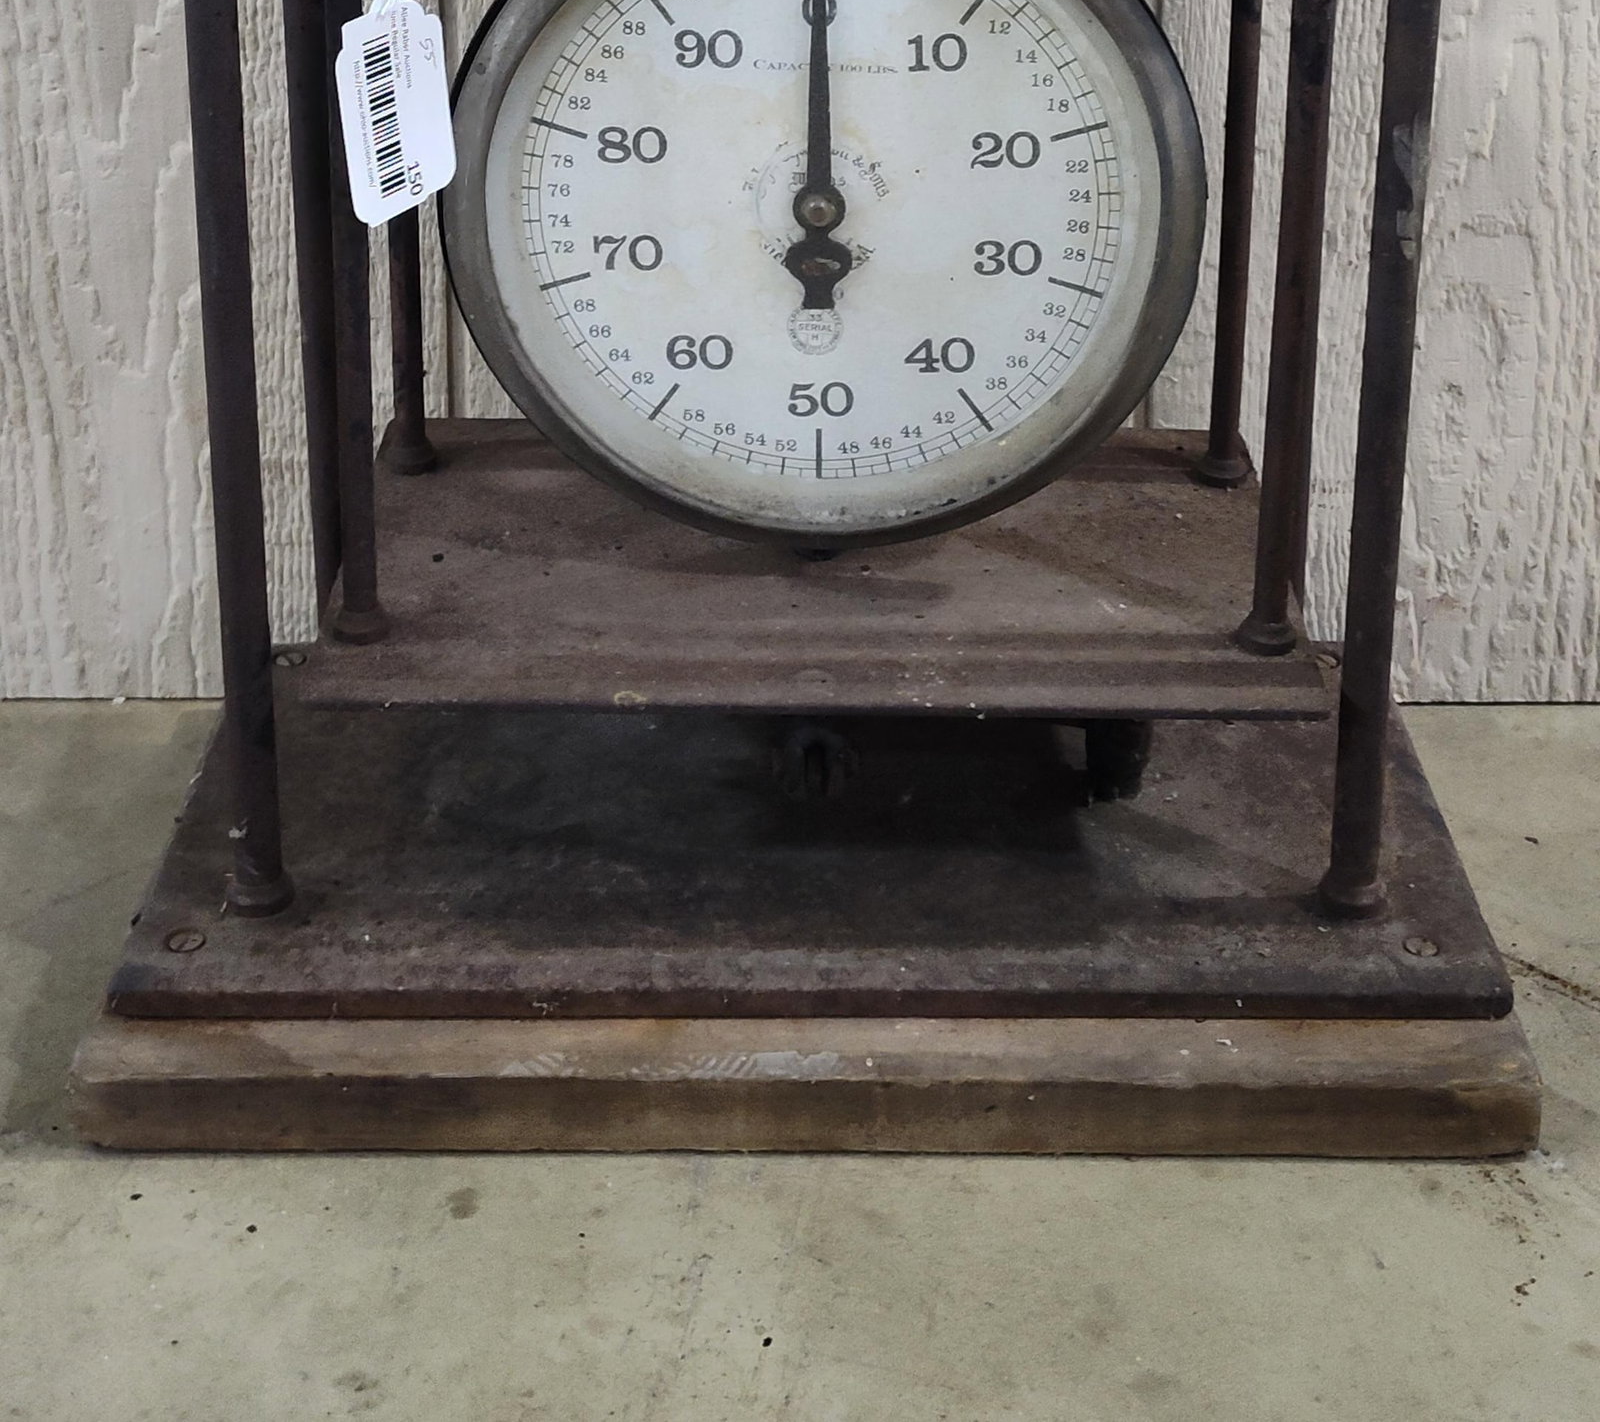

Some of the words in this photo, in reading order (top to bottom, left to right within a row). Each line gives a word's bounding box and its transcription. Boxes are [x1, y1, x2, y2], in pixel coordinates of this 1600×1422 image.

[623, 21, 645, 35] 88
[989, 20, 1011, 34] 12
[391, 30, 400, 60] Regular
[601, 45, 624, 59] 86
[674, 30, 742, 68] 90
[908, 34, 967, 72] 10
[1016, 49, 1037, 63] 14
[404, 54, 412, 89] Auctions
[584, 68, 607, 82] 84
[840, 64, 862, 72] 100
[1032, 74, 1053, 87] 16
[568, 96, 590, 110] 82
[1048, 98, 1069, 113] 18
[598, 127, 667, 163] 80
[971, 132, 1040, 169] 20
[551, 154, 573, 168] 78
[1066, 160, 1088, 173] 22
[407, 161, 423, 196] 150
[548, 184, 570, 197] 76
[1069, 189, 1091, 203] 24
[548, 214, 571, 227] 74
[1067, 220, 1090, 234] 26
[551, 241, 574, 253] 72
[593, 235, 663, 271] 70
[974, 240, 1042, 276] 30
[1063, 248, 1085, 262] 28
[574, 299, 596, 312] 68
[1043, 302, 1066, 318] 32
[589, 325, 611, 338] 66
[798, 322, 832, 332] SERIAL
[1025, 329, 1046, 343] 34
[609, 349, 631, 361] 64
[666, 335, 733, 370] 60
[904, 338, 975, 373] 40
[1006, 356, 1028, 368] 36
[632, 372, 654, 384] 62
[986, 377, 1007, 390] 38
[788, 382, 854, 417] 50
[683, 409, 705, 422] 58
[933, 412, 955, 424] 42
[714, 423, 735, 435] 56
[900, 426, 922, 438] 44
[744, 433, 766, 446] 54
[775, 439, 797, 452] 52
[870, 436, 892, 449] 46
[838, 442, 860, 454] 48
